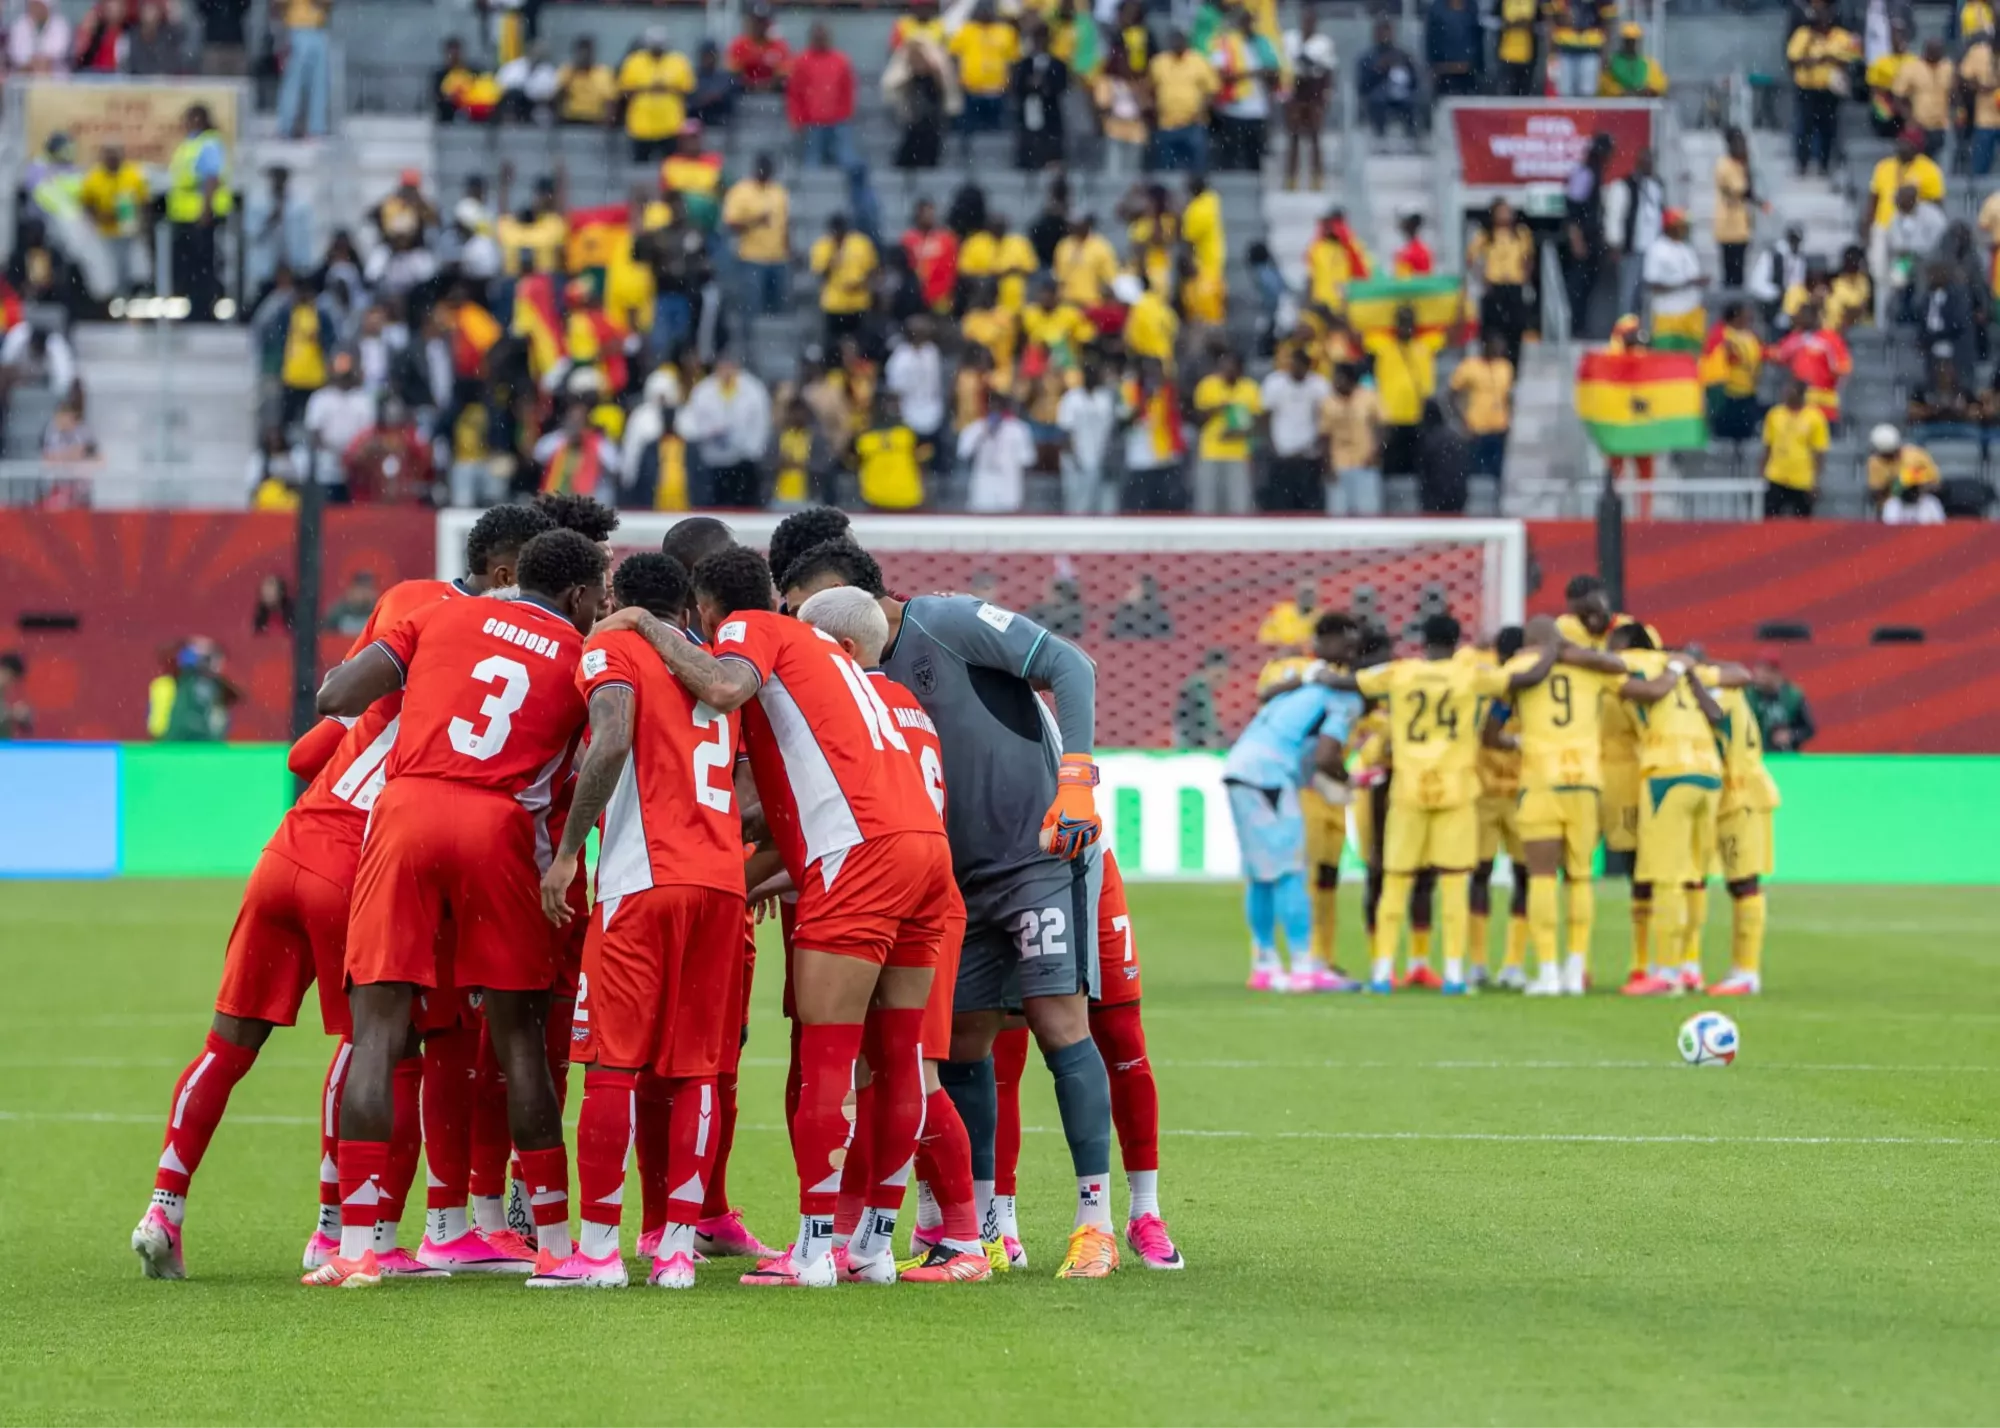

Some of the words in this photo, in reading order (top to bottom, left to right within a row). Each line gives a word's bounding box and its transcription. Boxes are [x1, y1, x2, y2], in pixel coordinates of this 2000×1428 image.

[482, 617, 560, 660] CORDOBA
[447, 654, 531, 761] 3
[1406, 689, 1458, 743] 24
[1551, 674, 1572, 728] 9
[692, 700, 732, 814] 2
[1020, 907, 1067, 959] 22
[1111, 914, 1133, 962] 7
